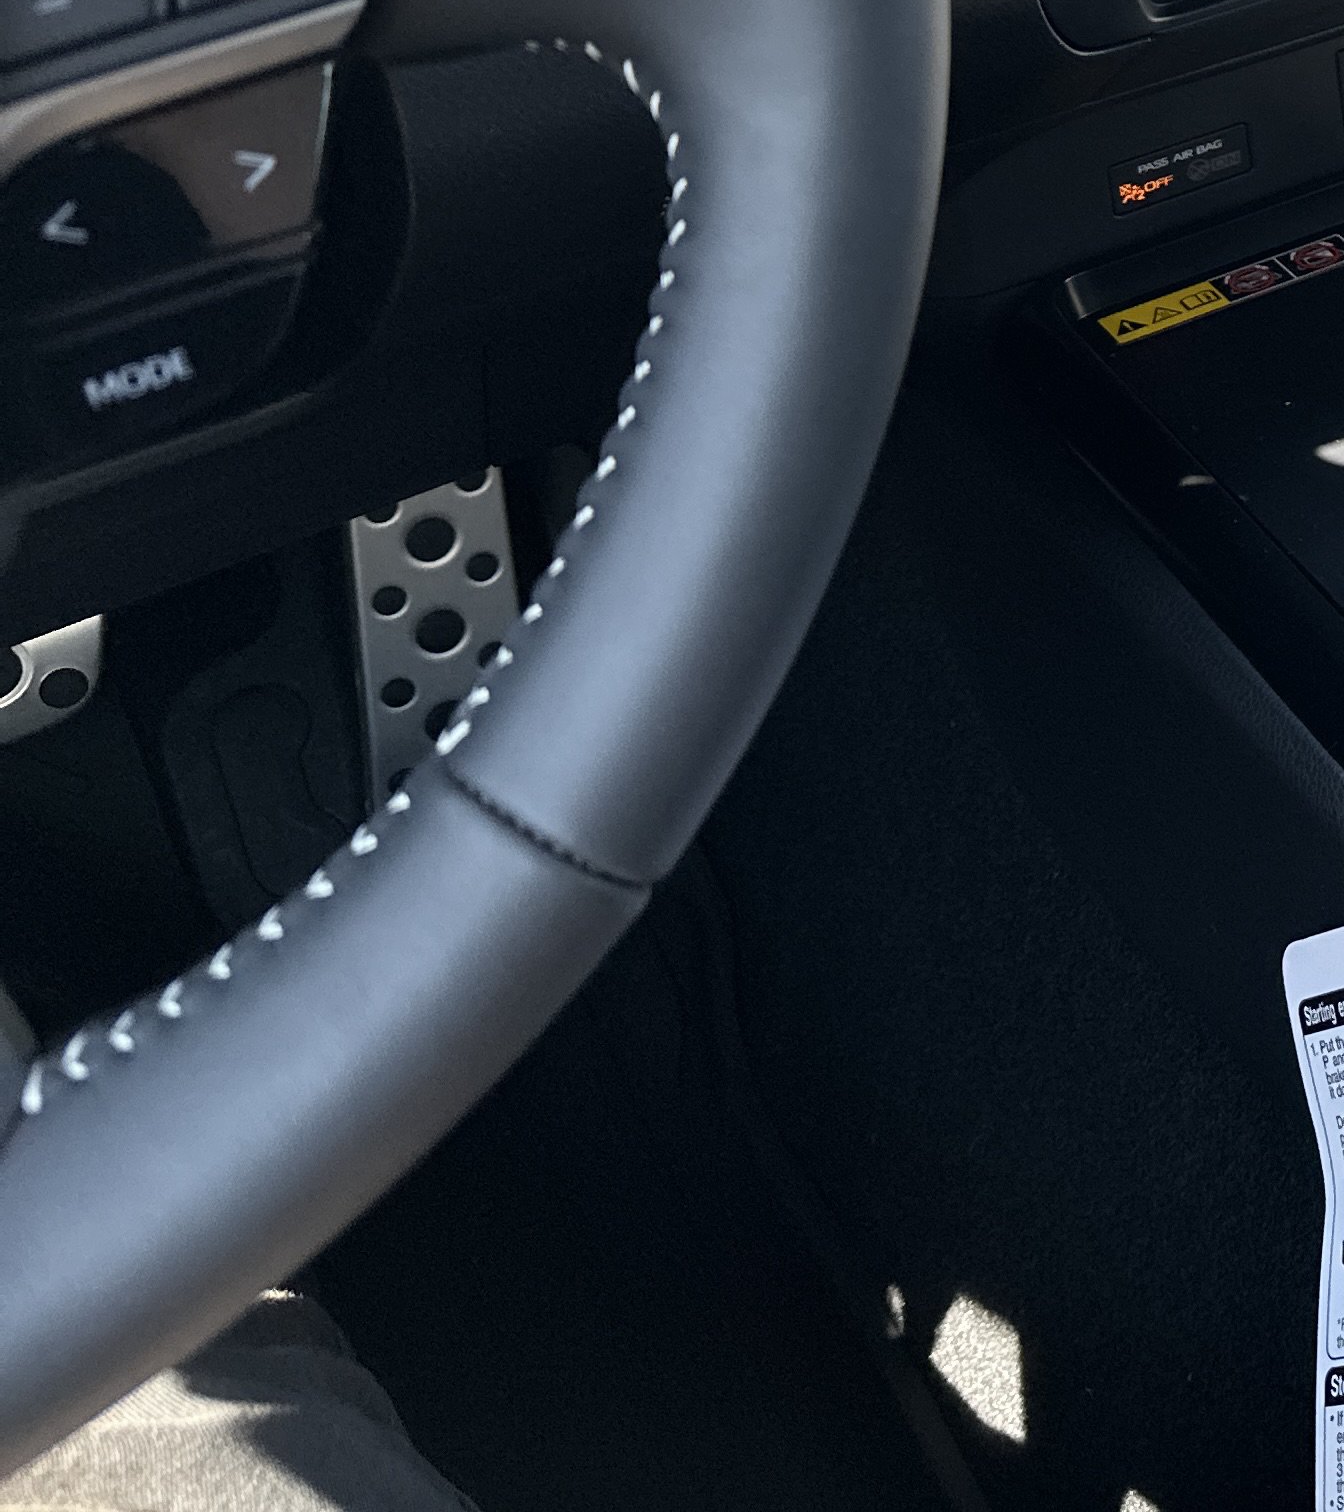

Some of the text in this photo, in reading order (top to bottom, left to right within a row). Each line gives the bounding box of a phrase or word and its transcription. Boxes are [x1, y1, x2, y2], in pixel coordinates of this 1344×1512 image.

[1138, 139, 1222, 173] PASS AIR BAG
[1144, 174, 1174, 192] OFF
[83, 347, 193, 410] MODE
[1304, 1001, 1338, 1027] Starting
[1337, 1411, 1343, 1426] If
[1336, 1462, 1343, 1477] 3
